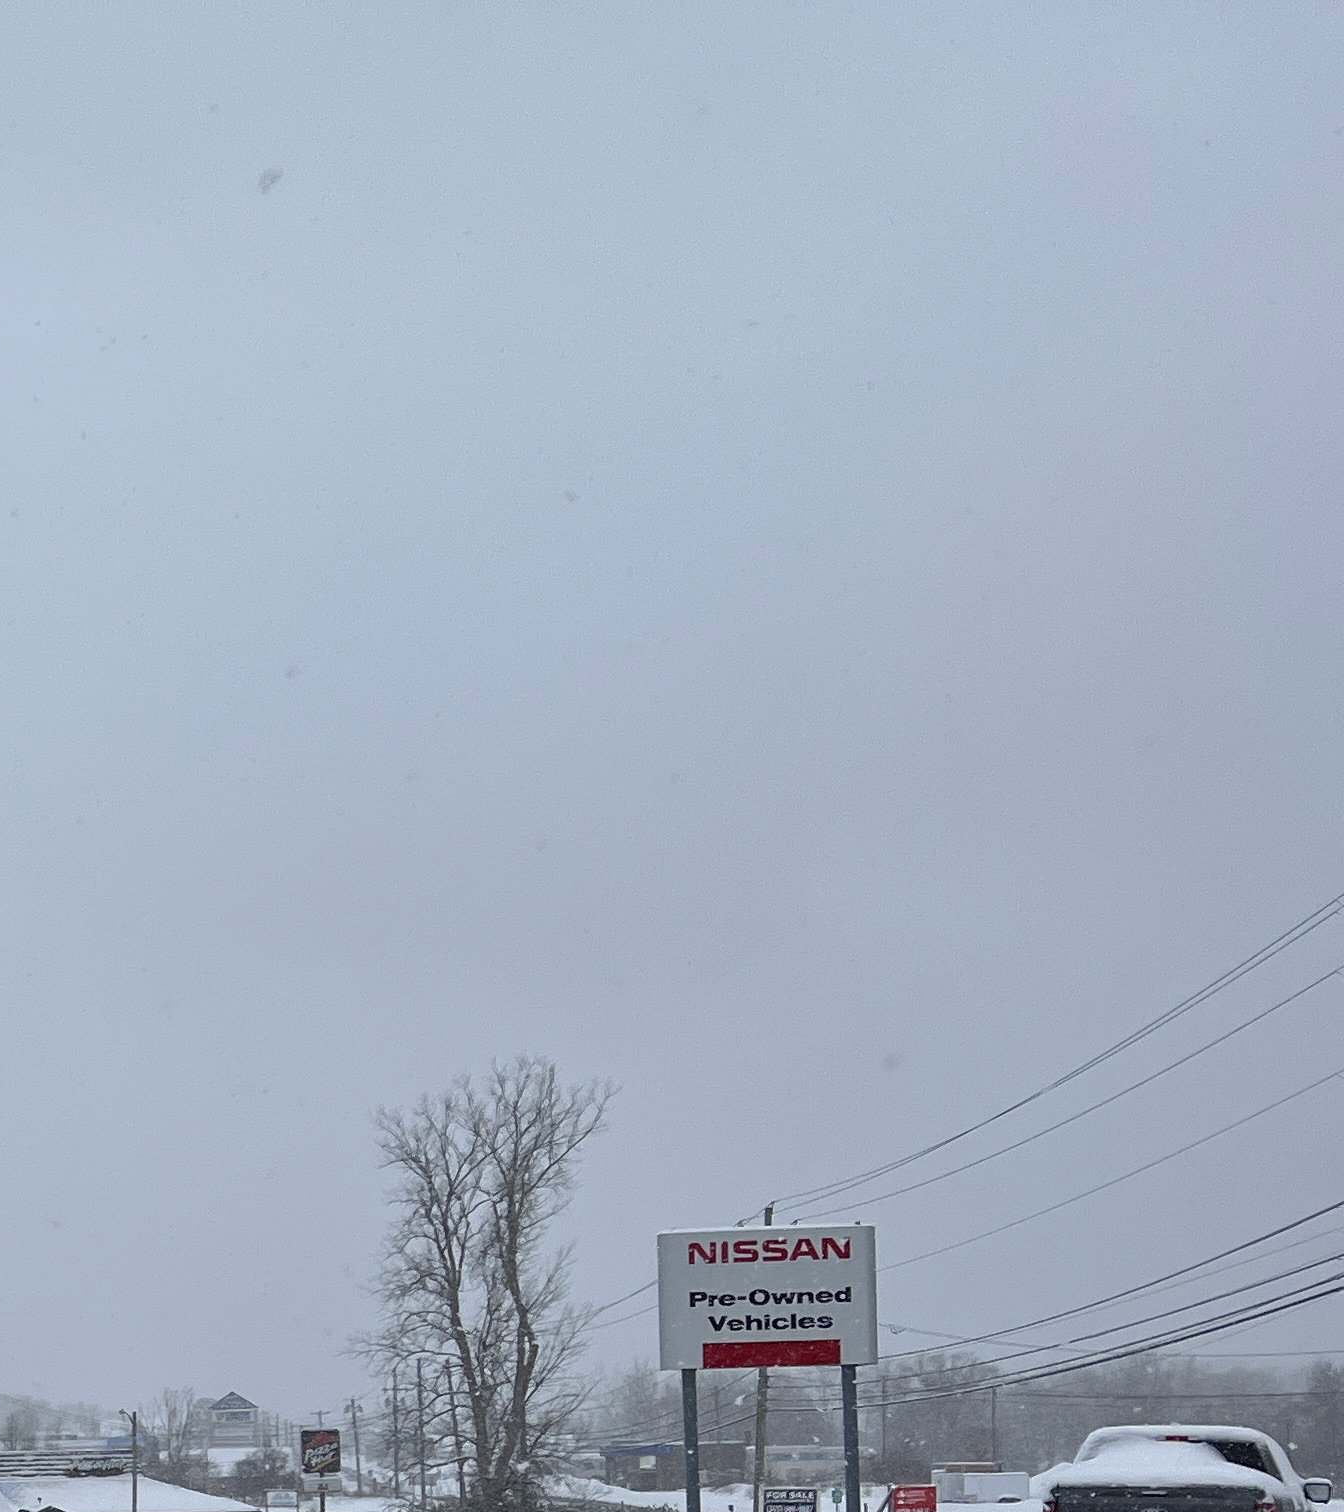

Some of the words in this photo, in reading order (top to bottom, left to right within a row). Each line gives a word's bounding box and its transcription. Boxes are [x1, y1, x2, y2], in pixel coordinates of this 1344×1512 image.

[688, 1236, 852, 1265] NISSAN
[689, 1286, 852, 1307] Pre-Owned
[708, 1313, 834, 1332] Vehicles
[765, 1490, 787, 1499] FOR
[789, 1490, 815, 1499] SALE
